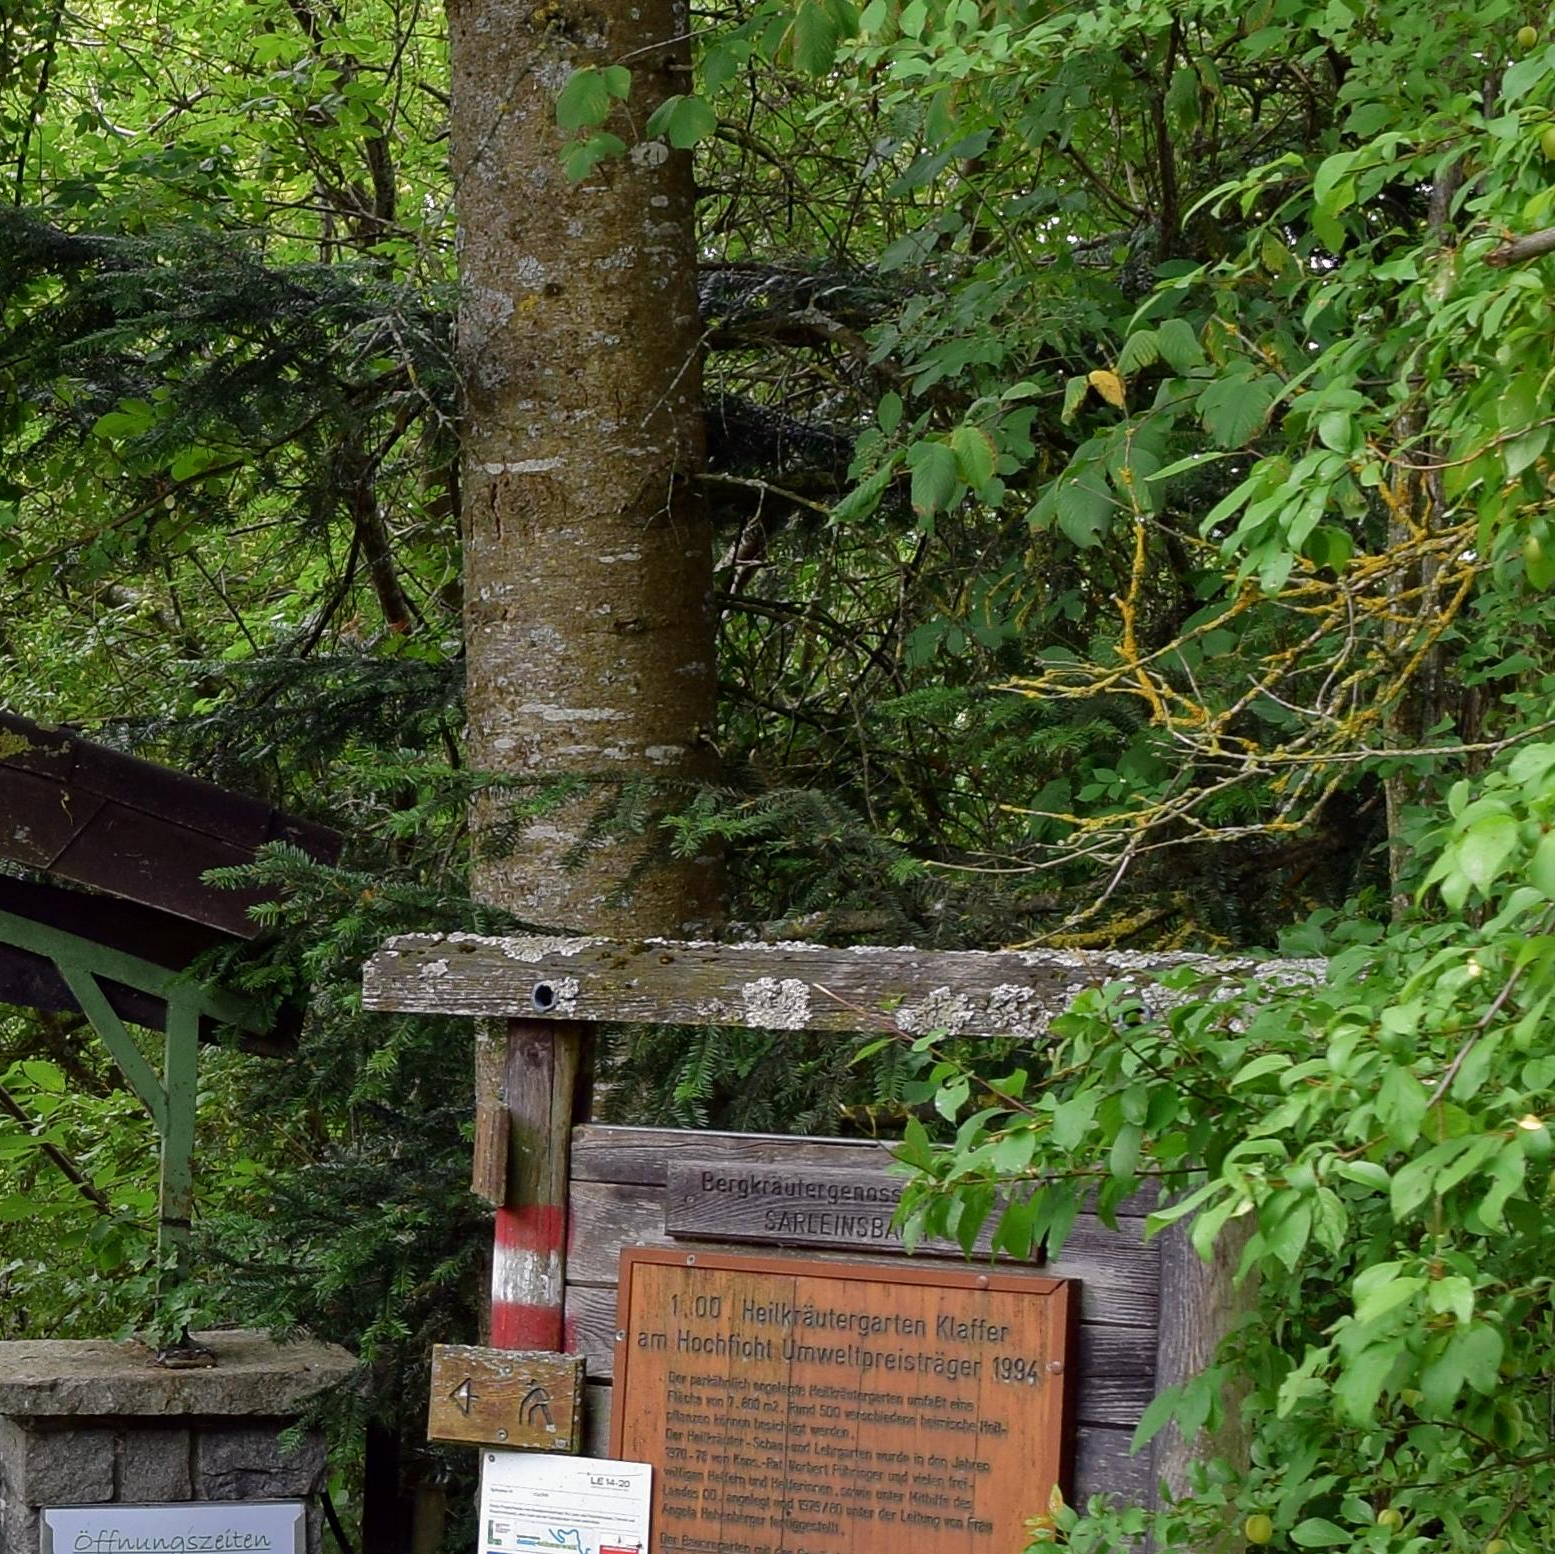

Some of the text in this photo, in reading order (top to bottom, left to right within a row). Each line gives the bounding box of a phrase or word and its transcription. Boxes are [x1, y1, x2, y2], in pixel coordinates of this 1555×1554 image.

[702, 1171, 902, 1204] Bergkräutergenoss
[764, 1210, 928, 1242] SARLEINSBA
[741, 1297, 926, 1341] Heilkräutergarten
[935, 1313, 1010, 1344] Klaffer
[637, 1328, 1039, 1383] am Hochficht Umweltpreisträger 1994
[667, 1390, 702, 1405] Fläche
[706, 1397, 723, 1407] von
[820, 1405, 840, 1419] 500
[845, 1408, 916, 1426] verschiedene
[920, 1415, 976, 1431] heimische
[668, 1370, 686, 1384] Der
[809, 1384, 904, 1407] Heilkräutergarten
[949, 1397, 974, 1411] eine
[665, 1410, 710, 1428] pflanzen
[713, 1414, 750, 1429] können
[754, 1418, 805, 1436] besichtigt
[664, 1428, 991, 1473] Der Lehrgarten wurde in den Jahren
[711, 1453, 943, 1486] von Norbert und vielen
[591, 1477, 604, 1486] LE
[663, 1465, 704, 1484] willigen
[707, 1470, 746, 1485] Helfern
[748, 1475, 768, 1488] und
[875, 1488, 904, 1502] unter
[908, 1491, 949, 1507] Mithilfe
[953, 1495, 973, 1509] des
[662, 1483, 700, 1499] Landes
[772, 1496, 794, 1509] und
[846, 1504, 874, 1519] unter
[877, 1507, 896, 1521] der
[899, 1509, 940, 1528] Leitung
[944, 1516, 964, 1528] von
[967, 1516, 993, 1533] Frau
[659, 1531, 677, 1545] Der
